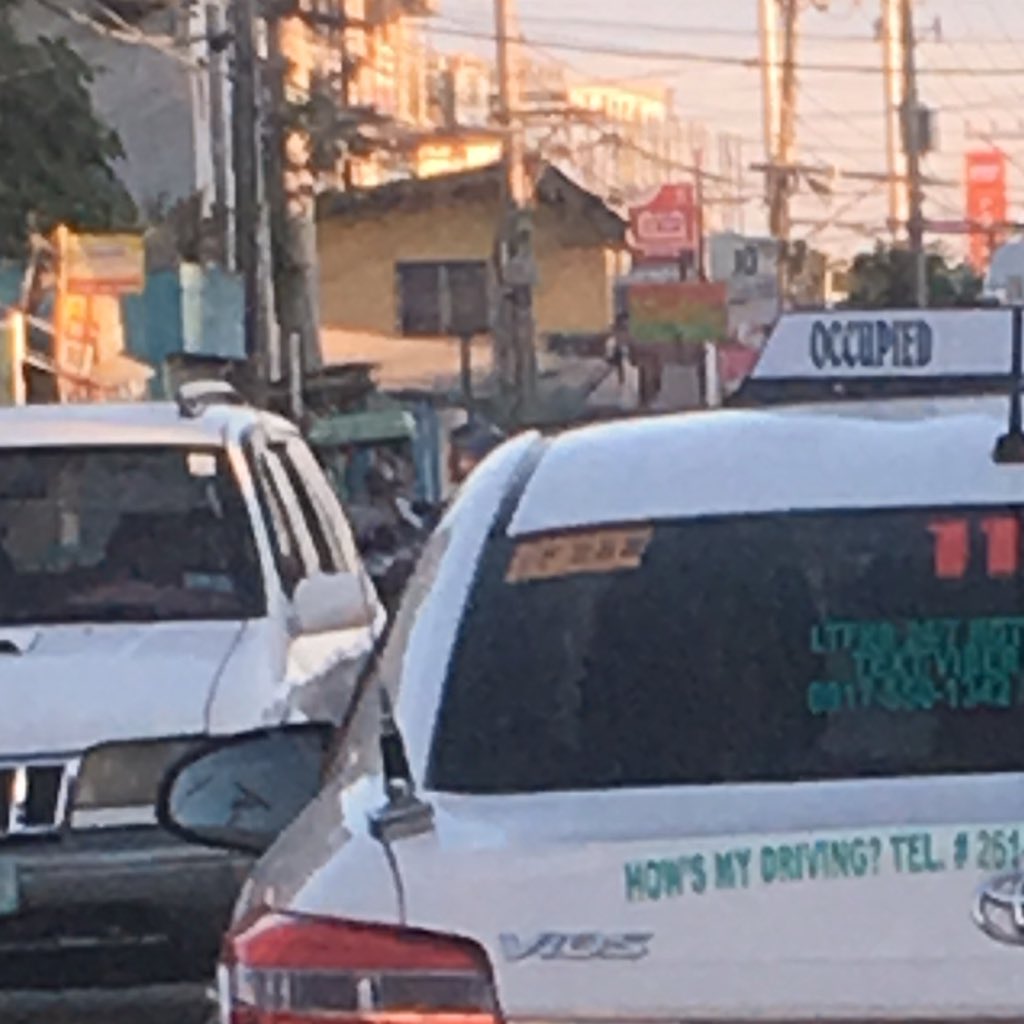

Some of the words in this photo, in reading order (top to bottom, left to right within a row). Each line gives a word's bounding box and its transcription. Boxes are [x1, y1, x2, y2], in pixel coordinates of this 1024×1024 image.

[811, 320, 933, 369] OCCUPIED
[624, 852, 706, 902] HOW'S
[715, 847, 752, 889] MY
[761, 833, 882, 884] DRIVING?
[890, 832, 944, 873] TEL.
[952, 832, 969, 870] #
